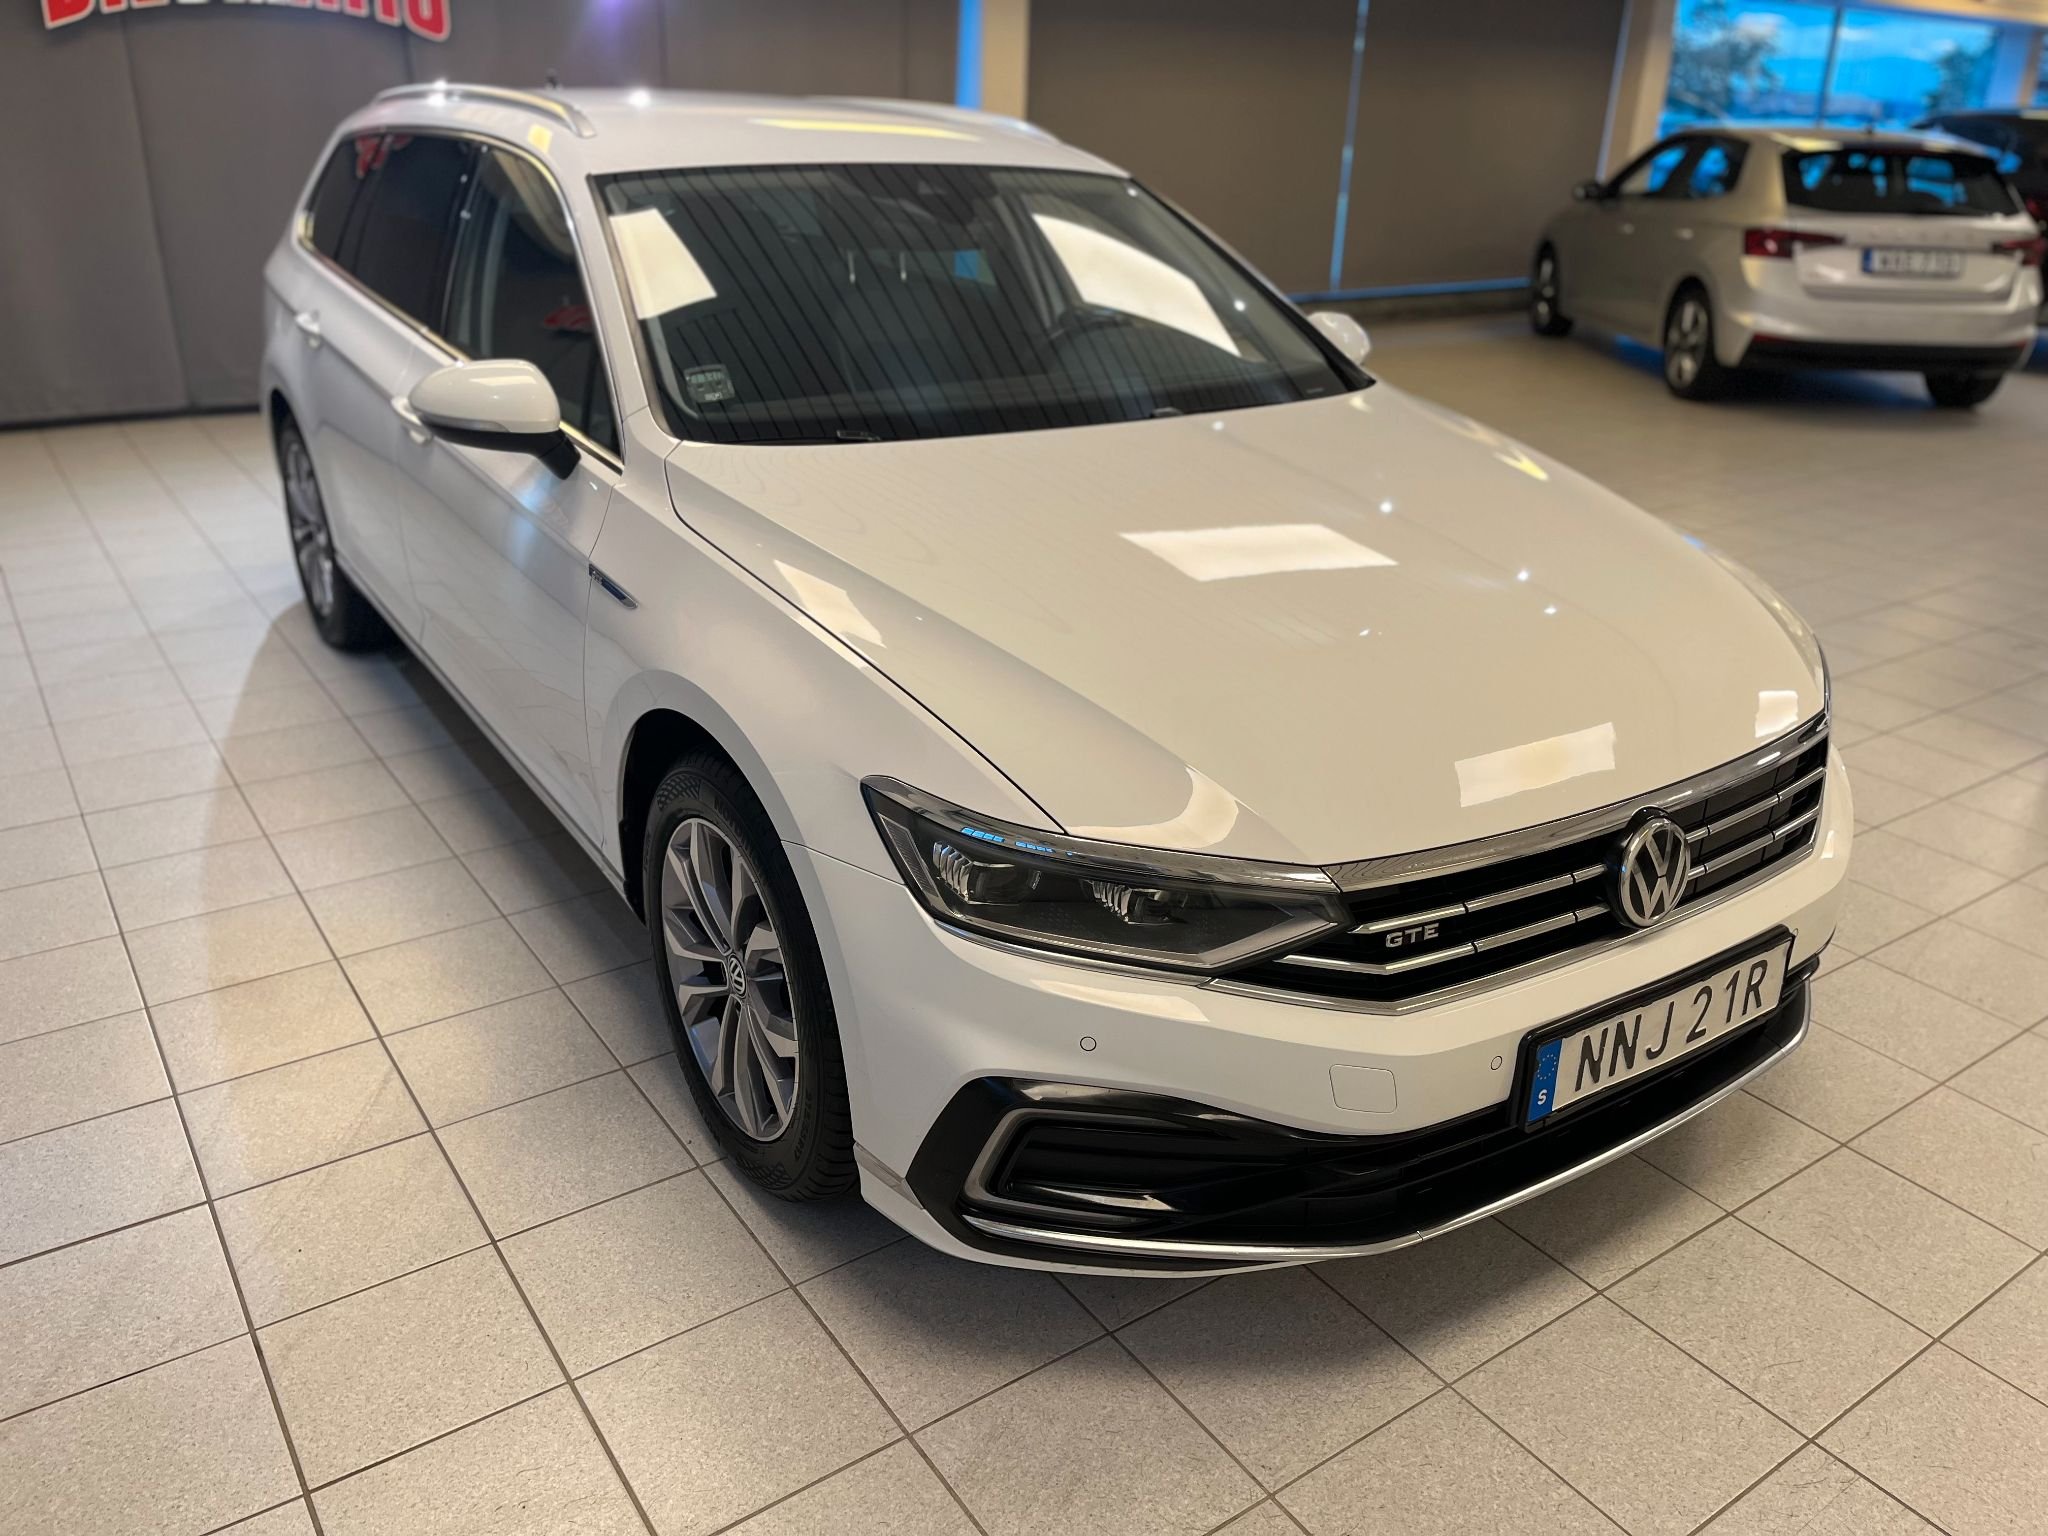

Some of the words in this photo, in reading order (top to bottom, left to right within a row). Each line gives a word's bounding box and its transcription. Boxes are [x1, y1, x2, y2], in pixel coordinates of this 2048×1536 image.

[1620, 817, 1690, 928] VW
[1385, 922, 1440, 949] GTE
[1574, 1001, 1675, 1092] NNJ
[1685, 959, 1769, 1044] 21R
[1537, 1089, 1548, 1106] S
